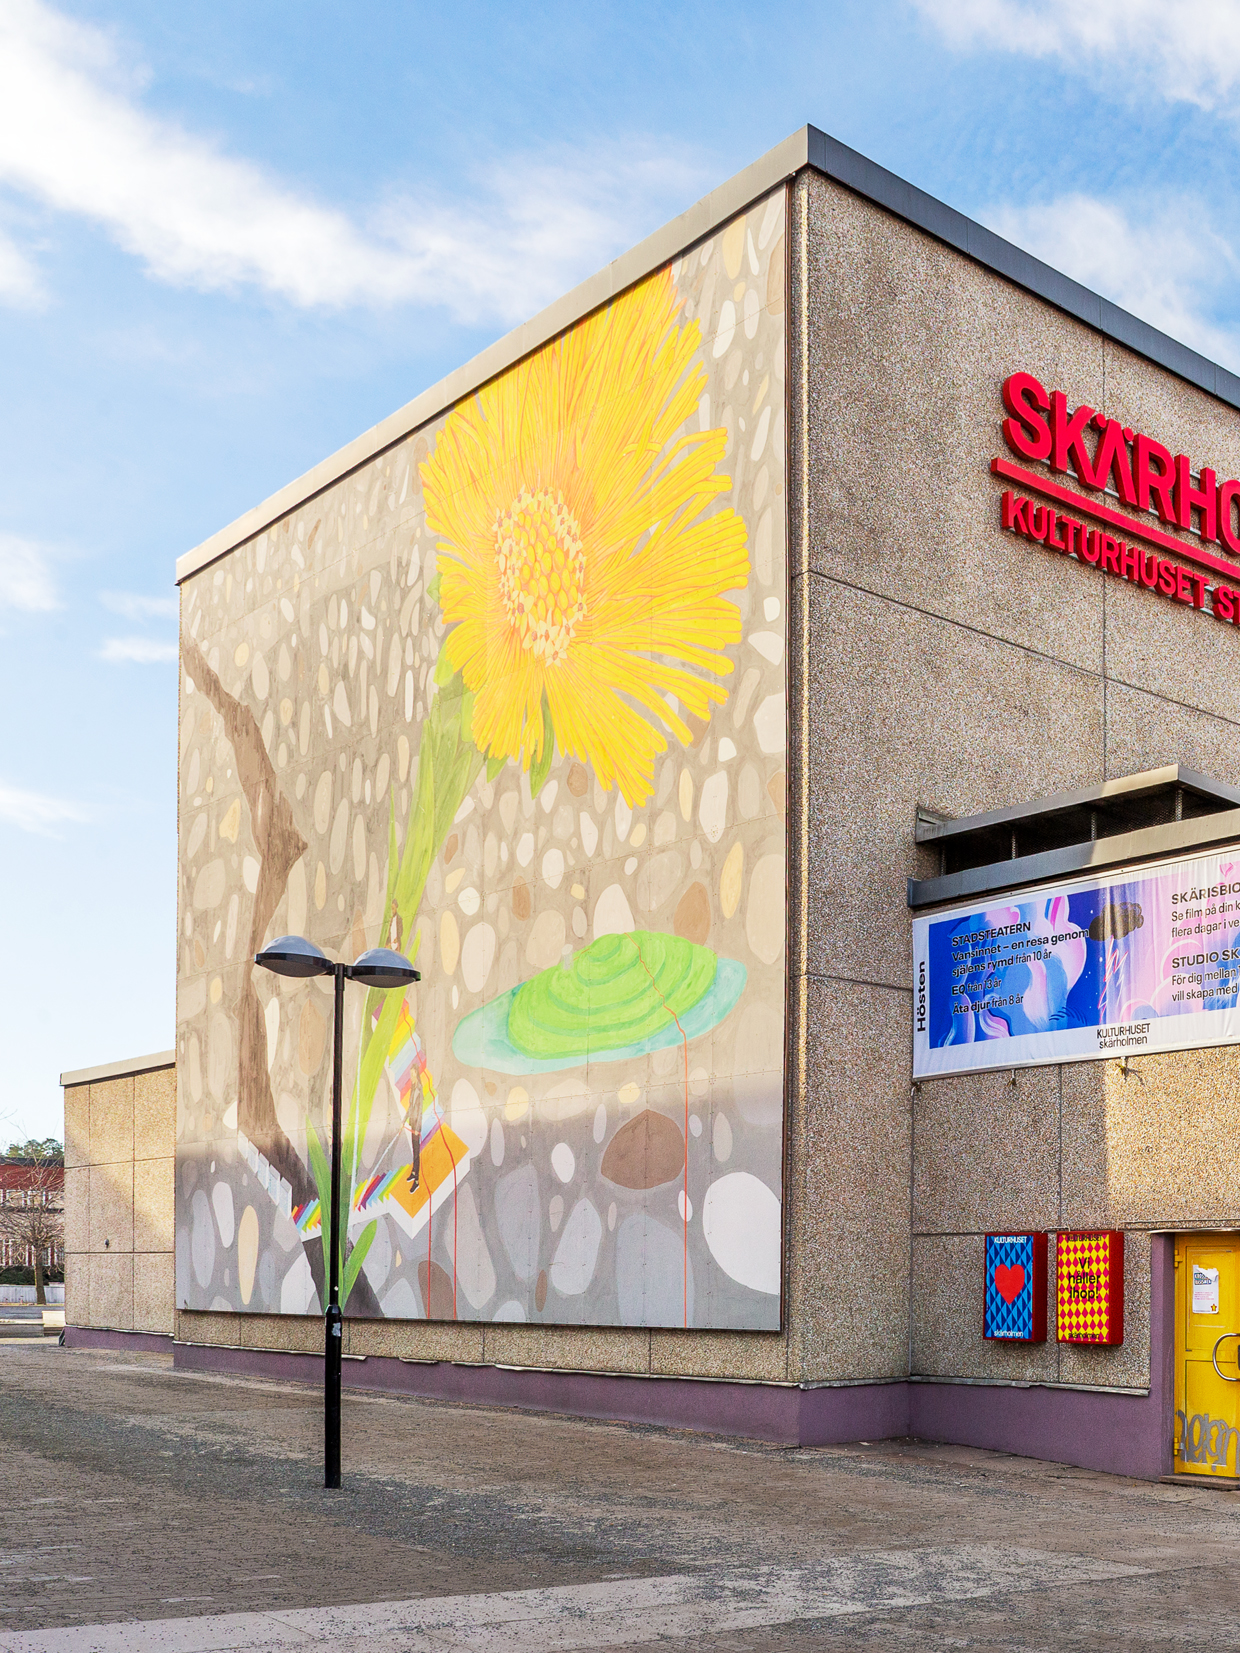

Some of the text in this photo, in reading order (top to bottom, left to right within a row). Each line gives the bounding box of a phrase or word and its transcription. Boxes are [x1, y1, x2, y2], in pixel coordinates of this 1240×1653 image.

[1001, 491, 1209, 609] KULTURHUSET
[1171, 910, 1184, 922] Se
[1185, 906, 1203, 920] film
[1204, 904, 1217, 920] på
[1218, 901, 1234, 914] din
[952, 922, 1031, 947] STADSTEATERN
[1171, 924, 1193, 938] flera
[1194, 921, 1221, 937] dagar
[952, 945, 1001, 962] Vansinnet
[1011, 941, 1024, 950] en
[1026, 936, 1049, 947] resa
[1051, 928, 1090, 945] genom
[952, 949, 1052, 977] själens rymd från 10 år
[1172, 951, 1219, 969] STUDIO
[1172, 974, 1186, 986] För
[1187, 971, 1202, 986] dig
[1204, 966, 1236, 982] mellan
[952, 978, 1002, 996] EQ från 13 år
[1172, 989, 1185, 1001] vill
[1186, 986, 1214, 1002] skapa
[1216, 984, 1238, 997] med
[917, 961, 926, 1032] Hösten
[952, 993, 1024, 1015] Äta djur från 8 år
[1096, 1022, 1150, 1039] KULTURHUSET
[1099, 1036, 1148, 1049] skärholmen
[994, 1236, 1027, 1244] KULTURHUSET
[1078, 1257, 1090, 1269] Vi
[1068, 1271, 1100, 1284] håller
[1070, 1287, 1098, 1302] ihop!
[994, 1329, 1024, 1338] skärholmen
